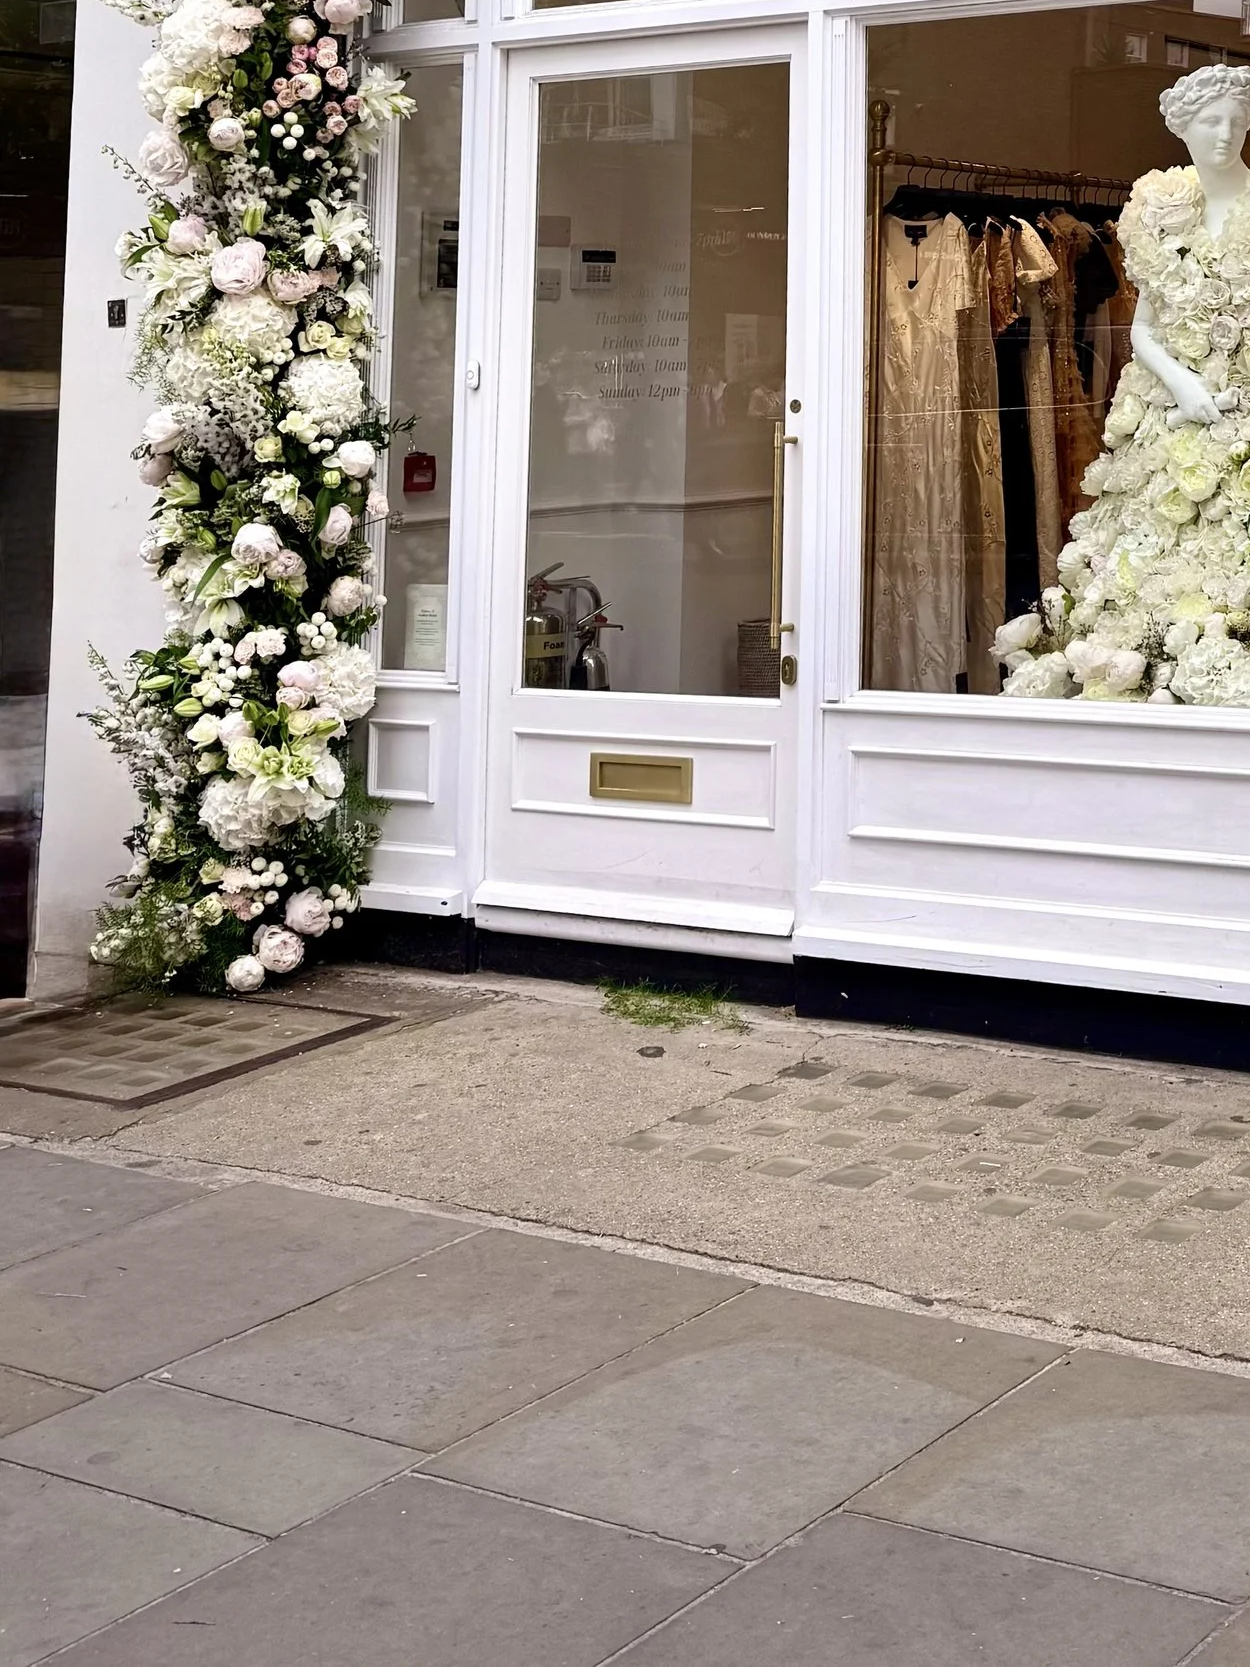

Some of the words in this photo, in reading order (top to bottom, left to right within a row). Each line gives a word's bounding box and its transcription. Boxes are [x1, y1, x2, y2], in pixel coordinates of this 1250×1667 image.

[647, 333, 680, 348] 10am
[654, 358, 687, 373] 10am
[648, 383, 681, 401] 12pm
